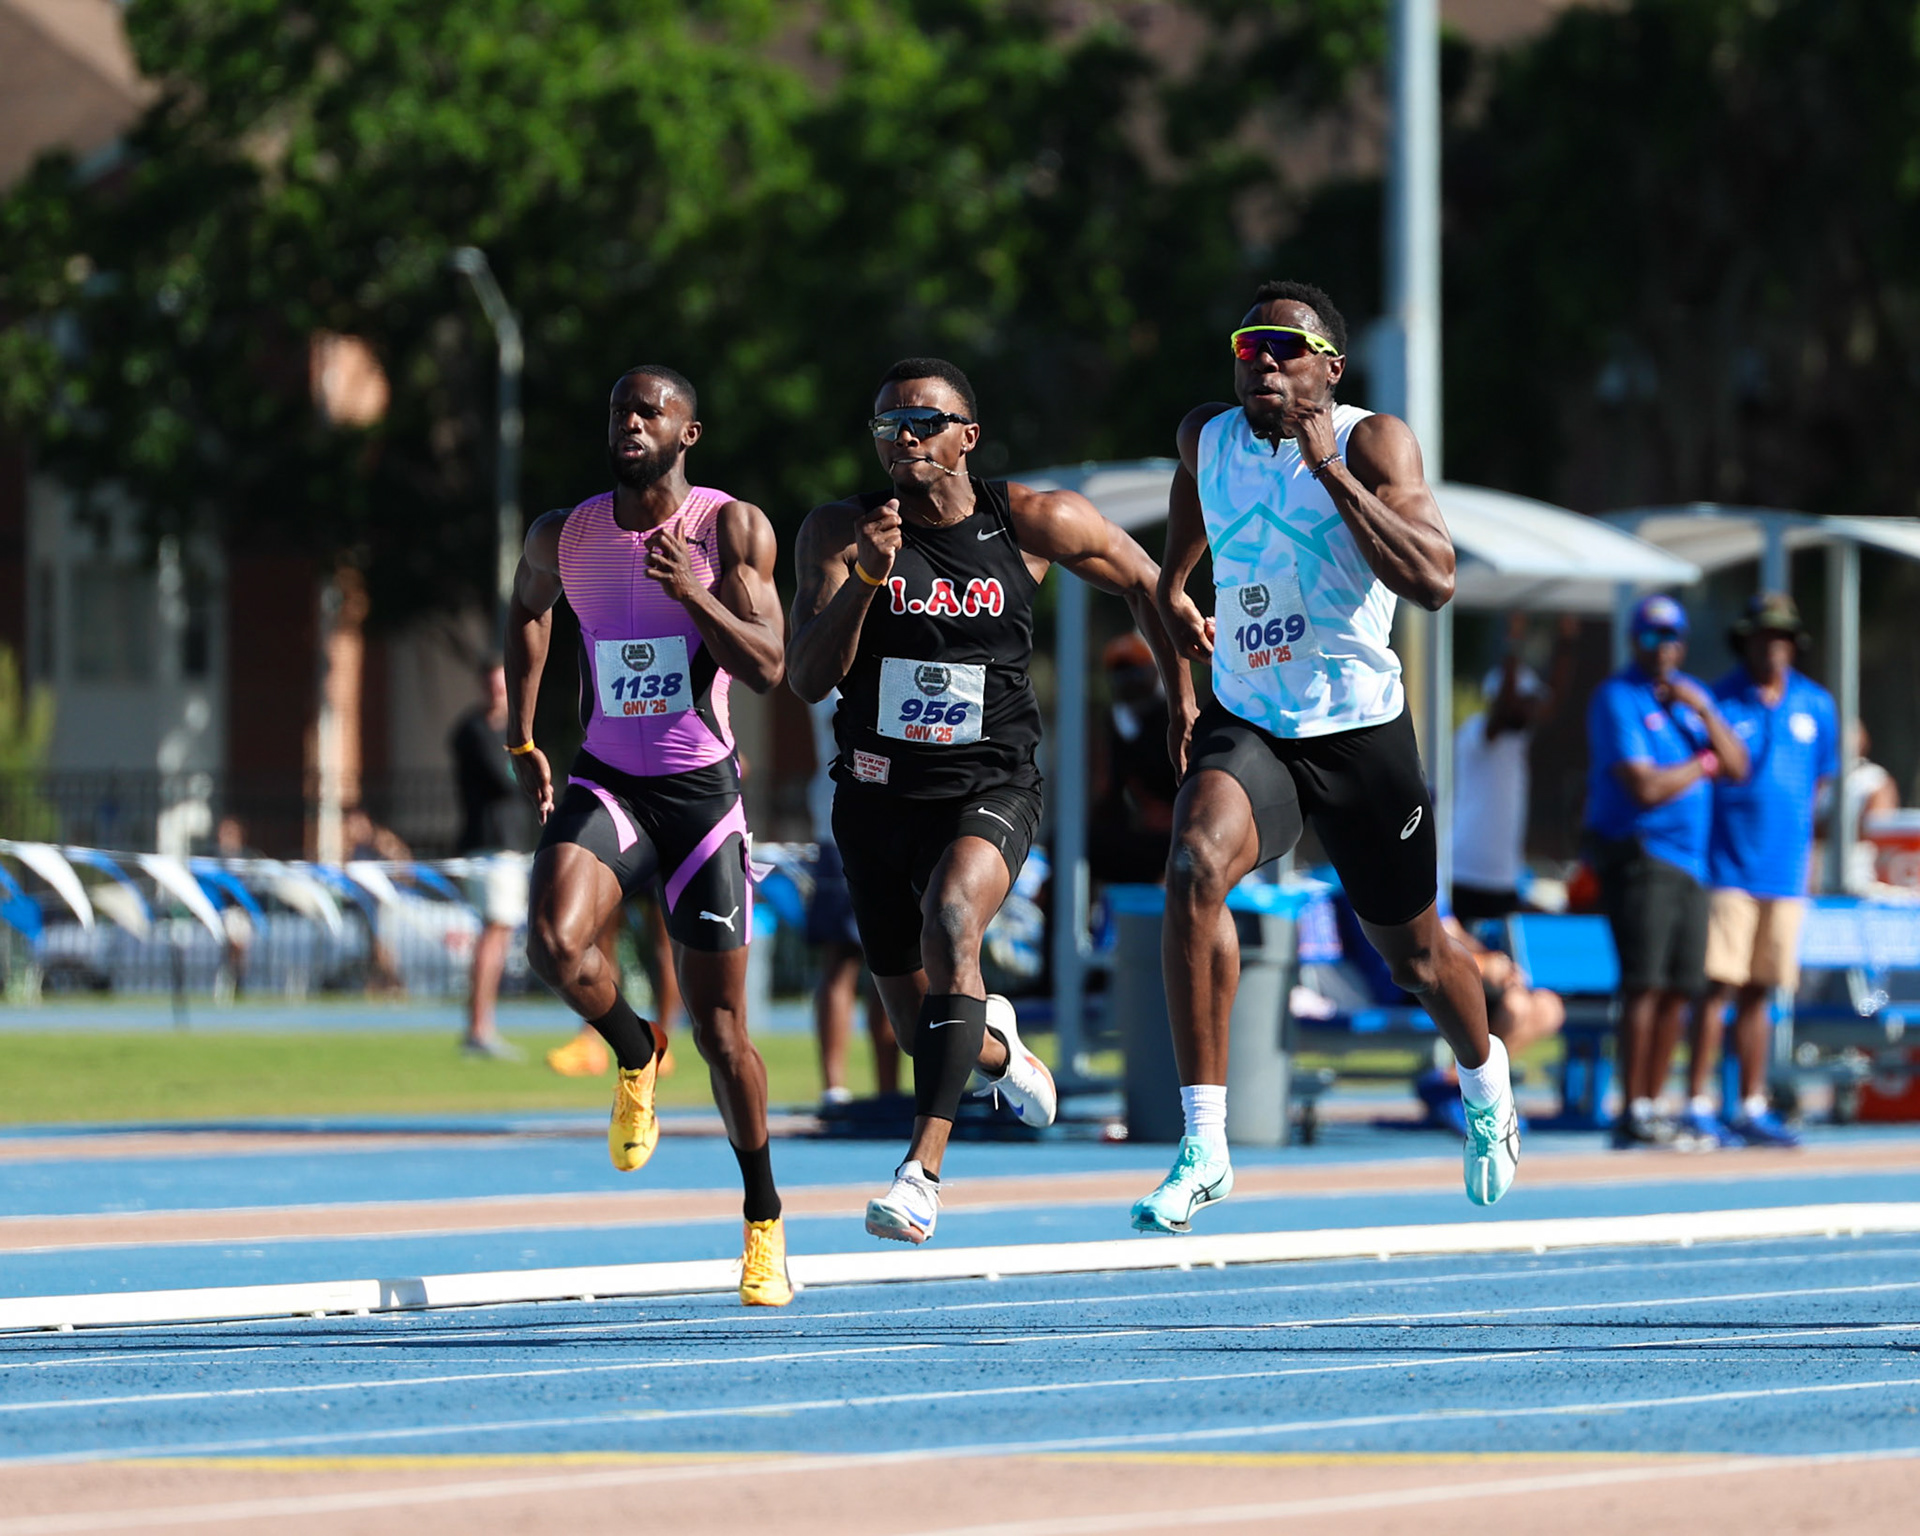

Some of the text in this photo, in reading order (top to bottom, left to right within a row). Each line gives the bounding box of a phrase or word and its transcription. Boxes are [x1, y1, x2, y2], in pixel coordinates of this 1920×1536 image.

[888, 576, 1005, 617] I.AM
[1234, 613, 1306, 652] 1069
[1248, 645, 1292, 669] GNV '25
[611, 672, 683, 700] 1138
[623, 699, 667, 715] GNV '25
[899, 698, 970, 726] 956
[905, 725, 953, 742] GNV '25
